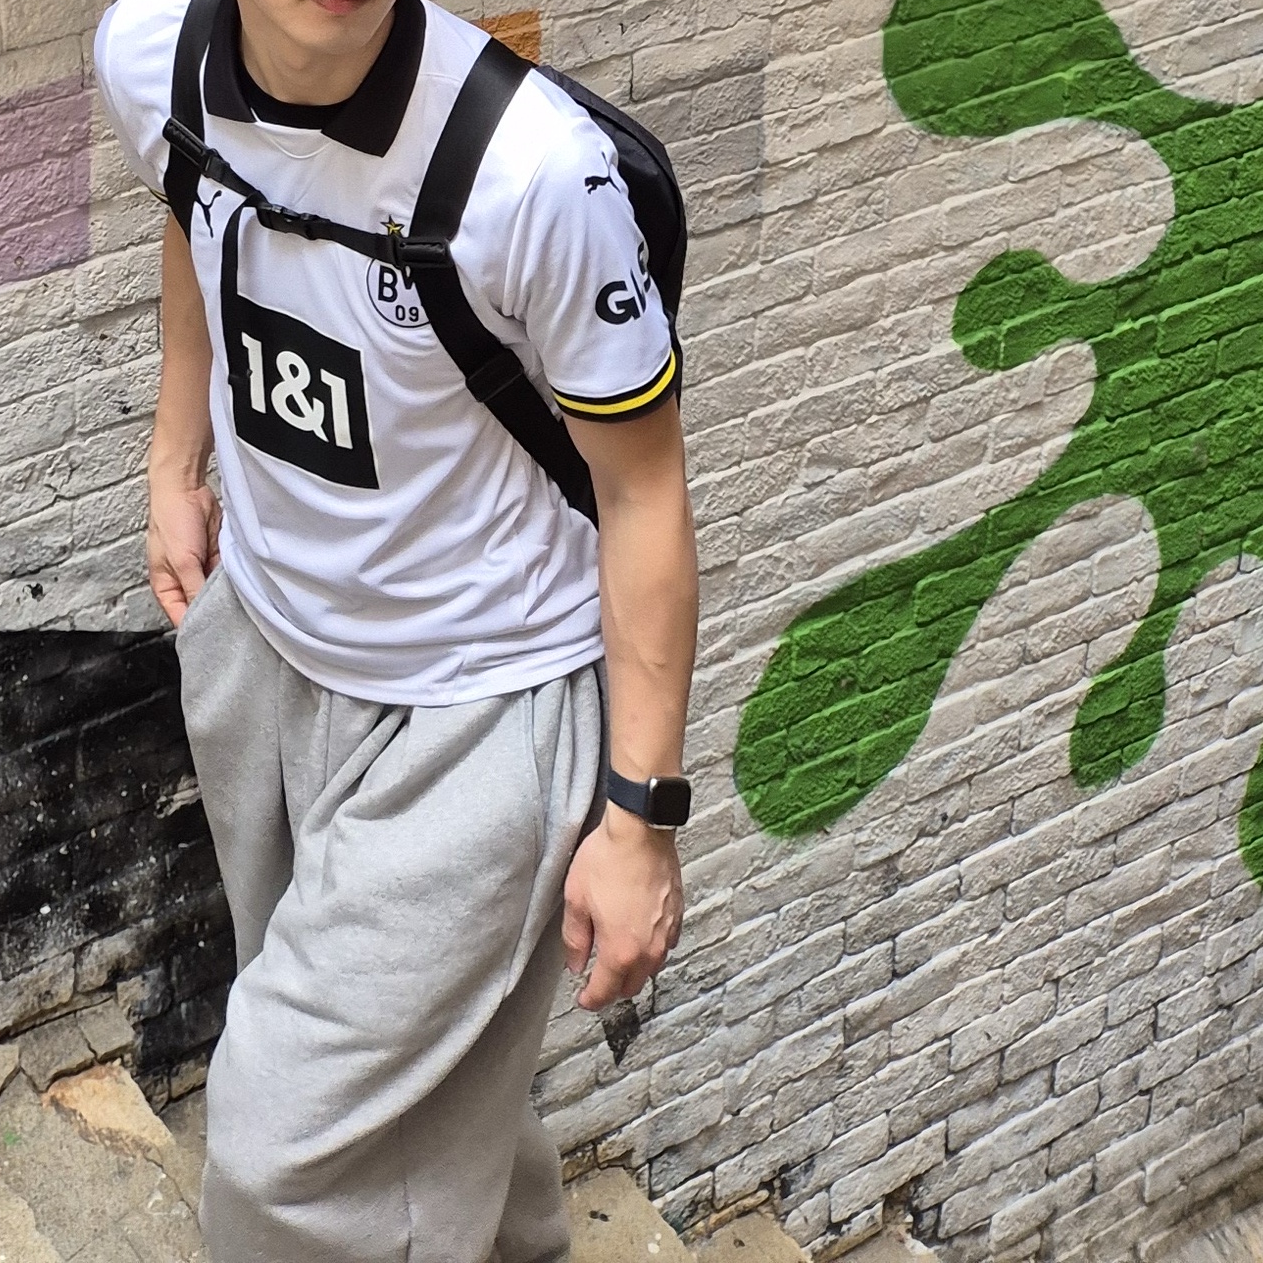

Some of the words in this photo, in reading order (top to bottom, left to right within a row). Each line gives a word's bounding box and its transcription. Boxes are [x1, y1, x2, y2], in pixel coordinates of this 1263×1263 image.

[378, 265, 415, 303] BV
[395, 305, 419, 322] 09
[241, 331, 353, 450] 1&1
